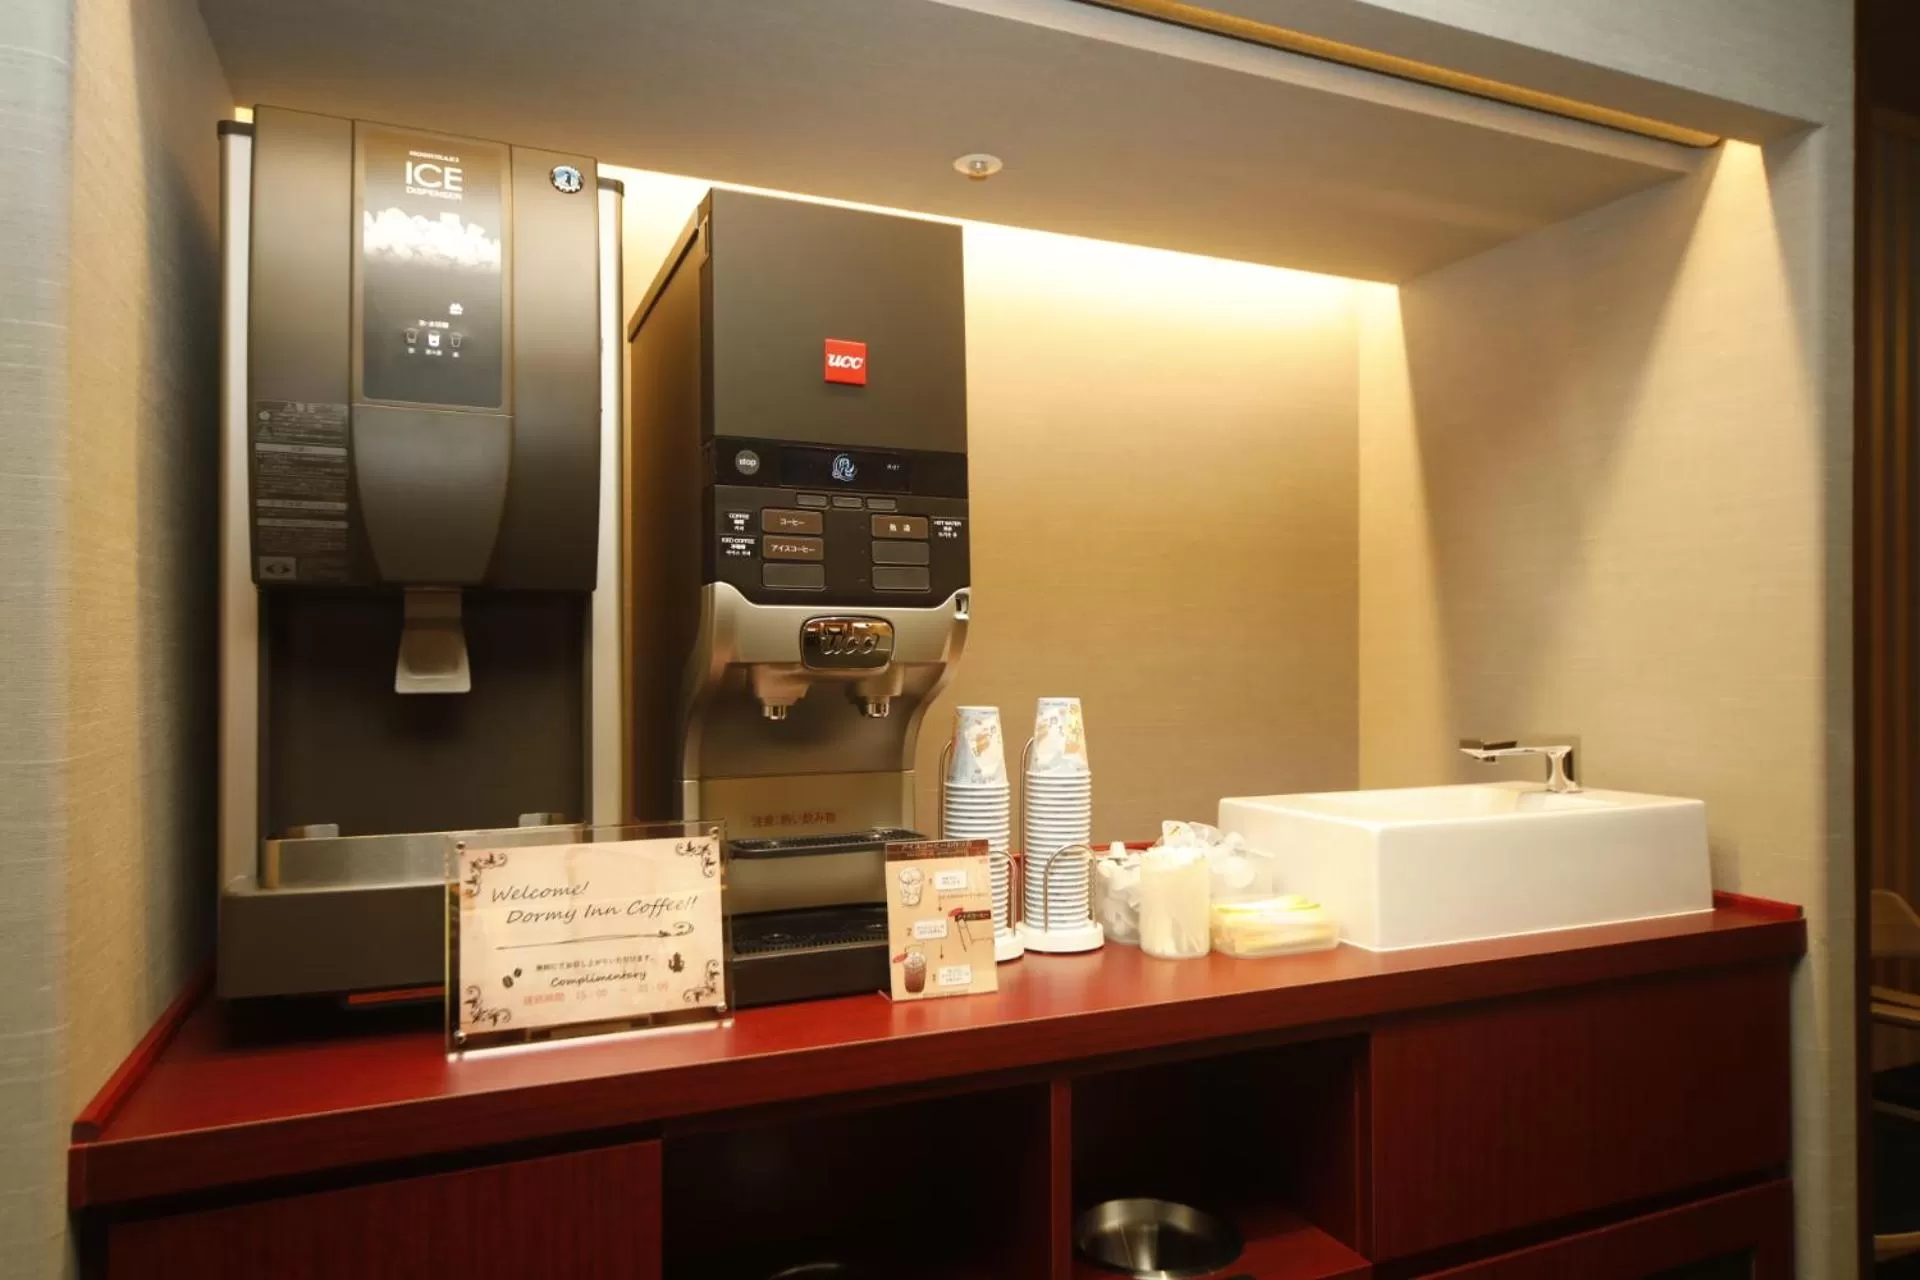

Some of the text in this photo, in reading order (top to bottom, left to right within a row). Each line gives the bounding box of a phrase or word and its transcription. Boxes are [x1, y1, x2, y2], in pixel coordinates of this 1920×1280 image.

[405, 160, 464, 192] ICE
[739, 458, 756, 468] stop
[780, 518, 805, 526] コーヒー
[770, 544, 816, 553] アイスコーヒー
[491, 881, 590, 903] Welcome!
[506, 895, 699, 924] Dormy Inn Coffee!!
[550, 970, 646, 988] Complimentary
